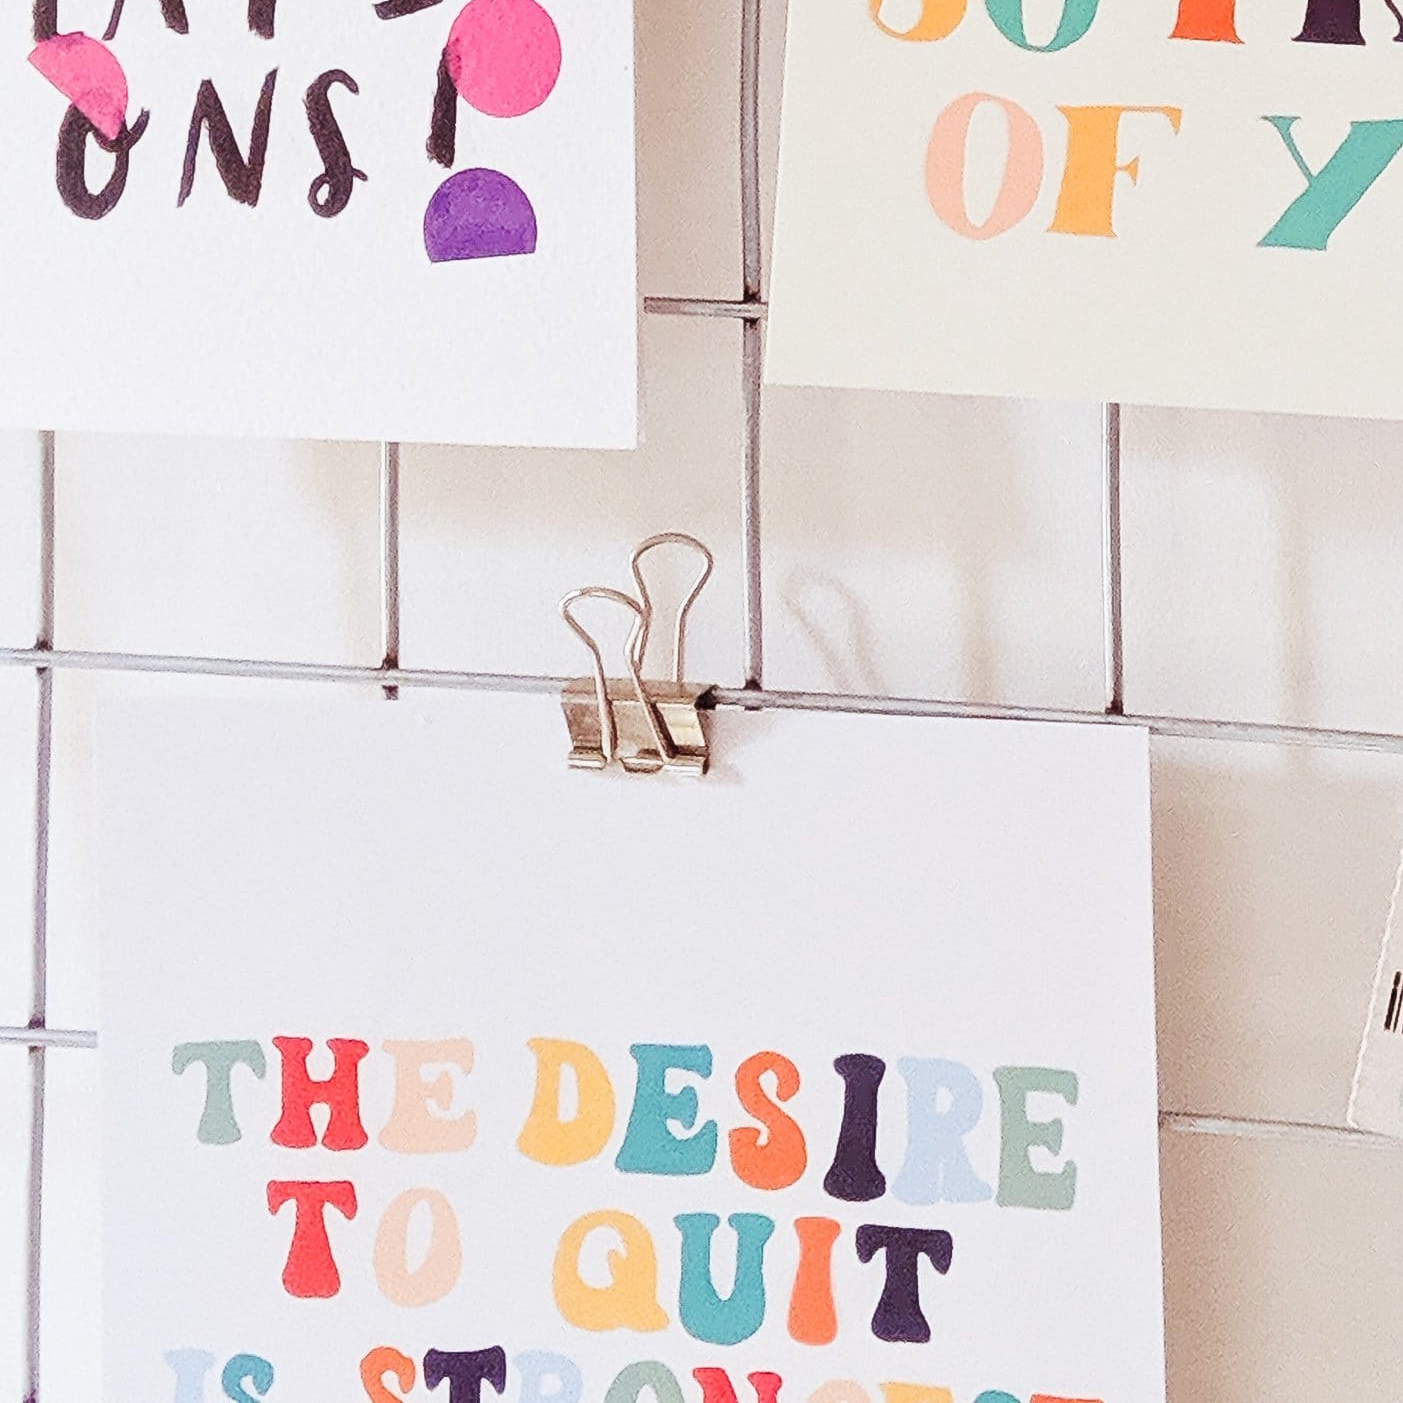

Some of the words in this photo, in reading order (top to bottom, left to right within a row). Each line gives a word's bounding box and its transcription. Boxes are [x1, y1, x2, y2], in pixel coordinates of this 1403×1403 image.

[924, 91, 1183, 240] OF
[170, 1036, 478, 1154] THE
[517, 1036, 1079, 1211] DESIRE
[266, 1179, 463, 1308] TO
[551, 1208, 954, 1347] QUIT
